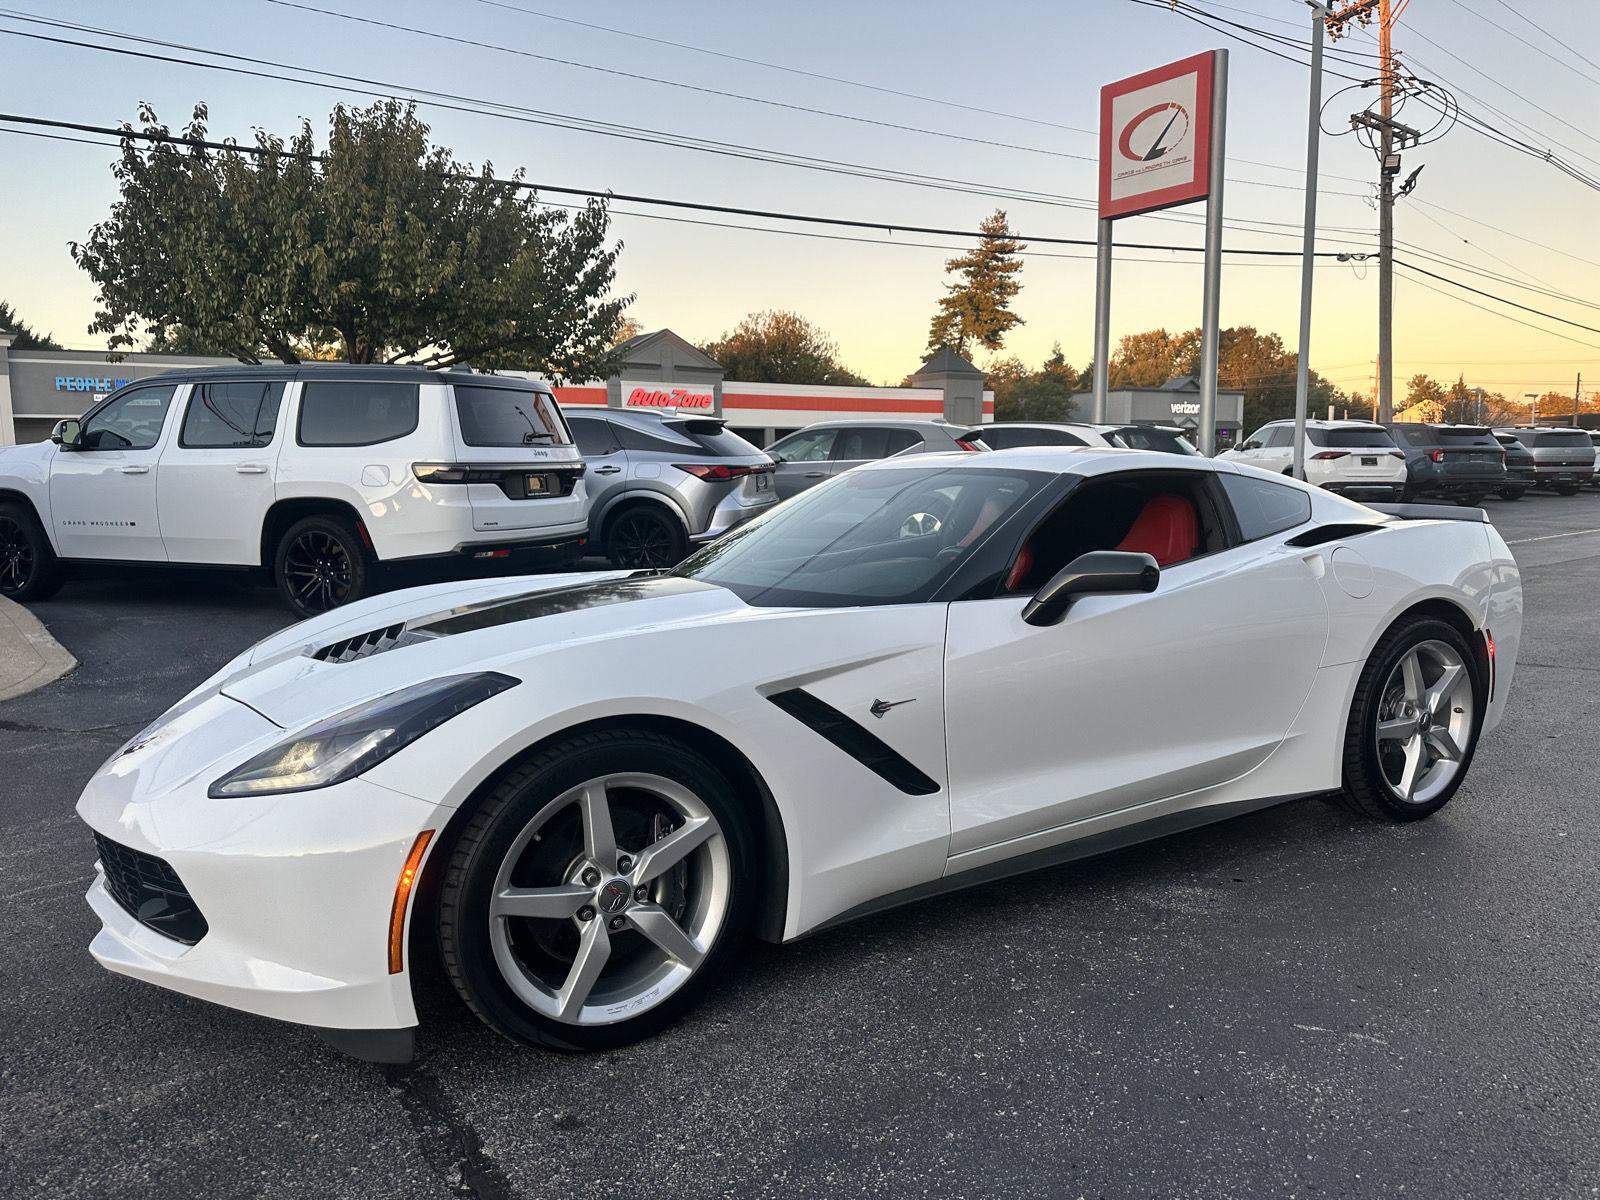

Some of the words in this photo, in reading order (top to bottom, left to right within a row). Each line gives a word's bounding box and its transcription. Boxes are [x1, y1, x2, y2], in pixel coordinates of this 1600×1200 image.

[55, 376, 112, 391] PEOPLE
[627, 387, 713, 408] AutoZone
[533, 448, 548, 457] Jeep
